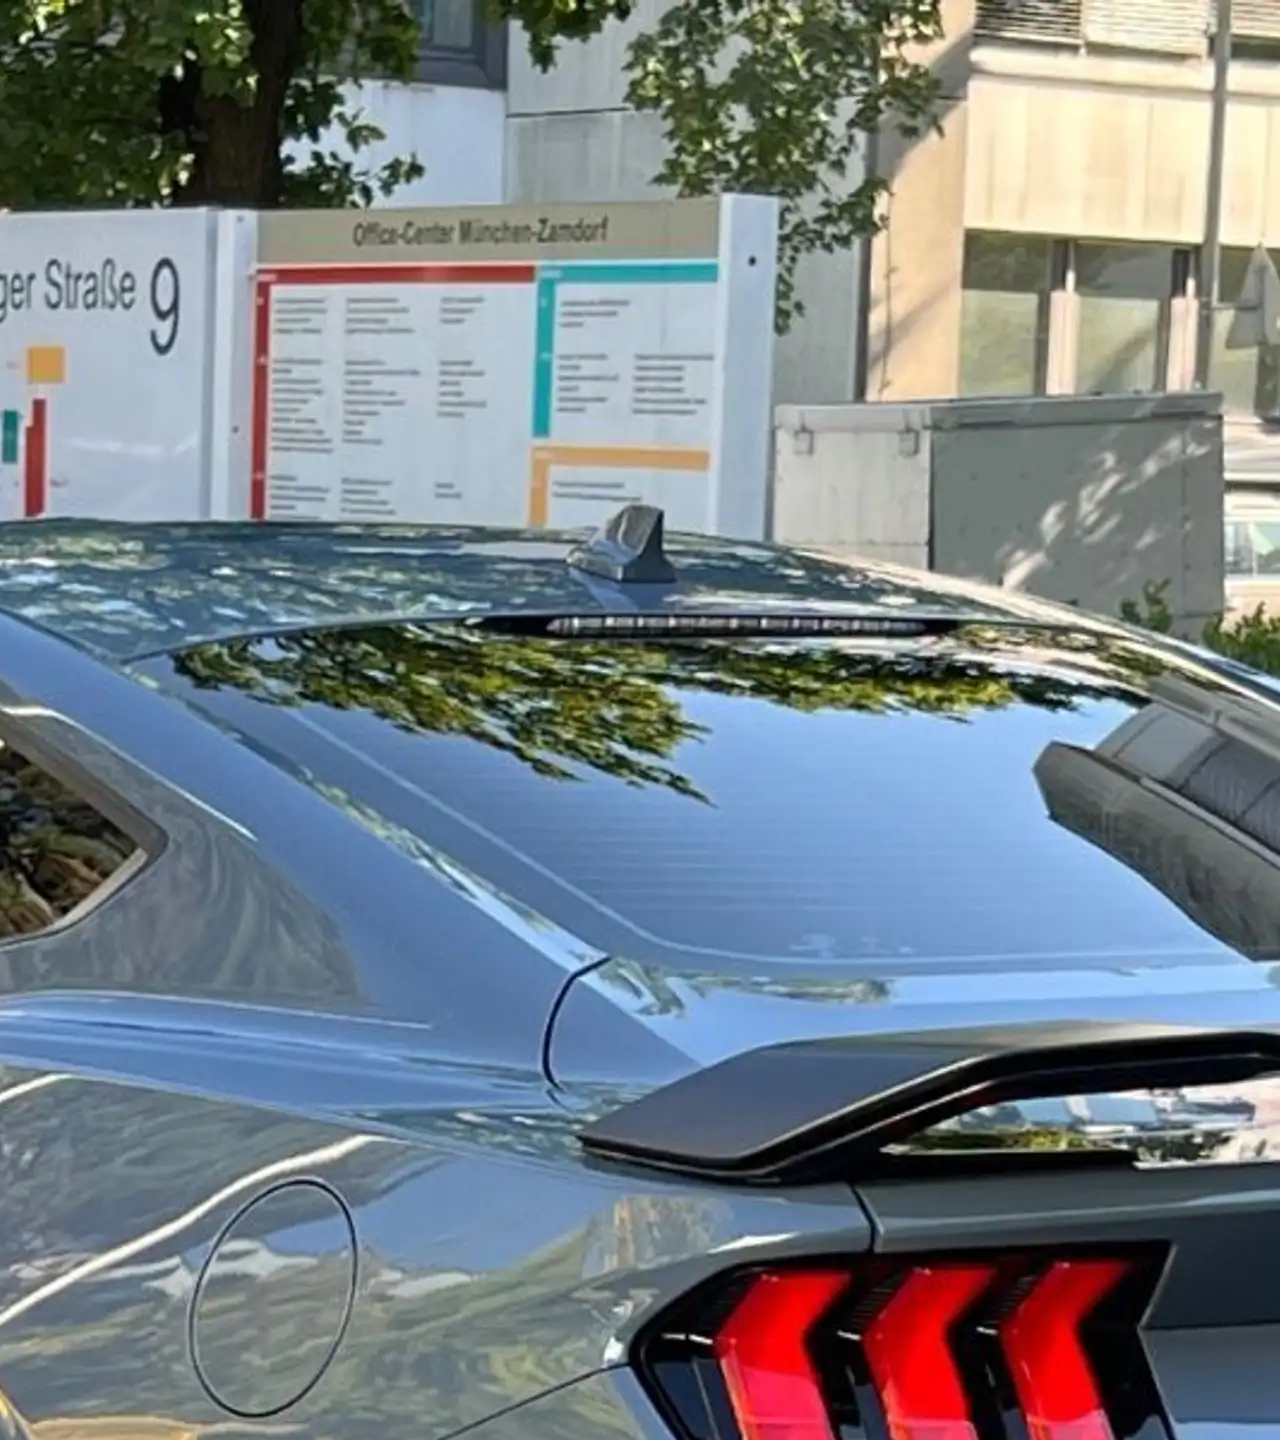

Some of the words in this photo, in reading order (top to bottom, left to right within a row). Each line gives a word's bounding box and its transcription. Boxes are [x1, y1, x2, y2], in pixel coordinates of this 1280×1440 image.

[352, 219, 455, 247] Office-Center
[44, 257, 137, 312] Straße
[149, 256, 181, 356] 9
